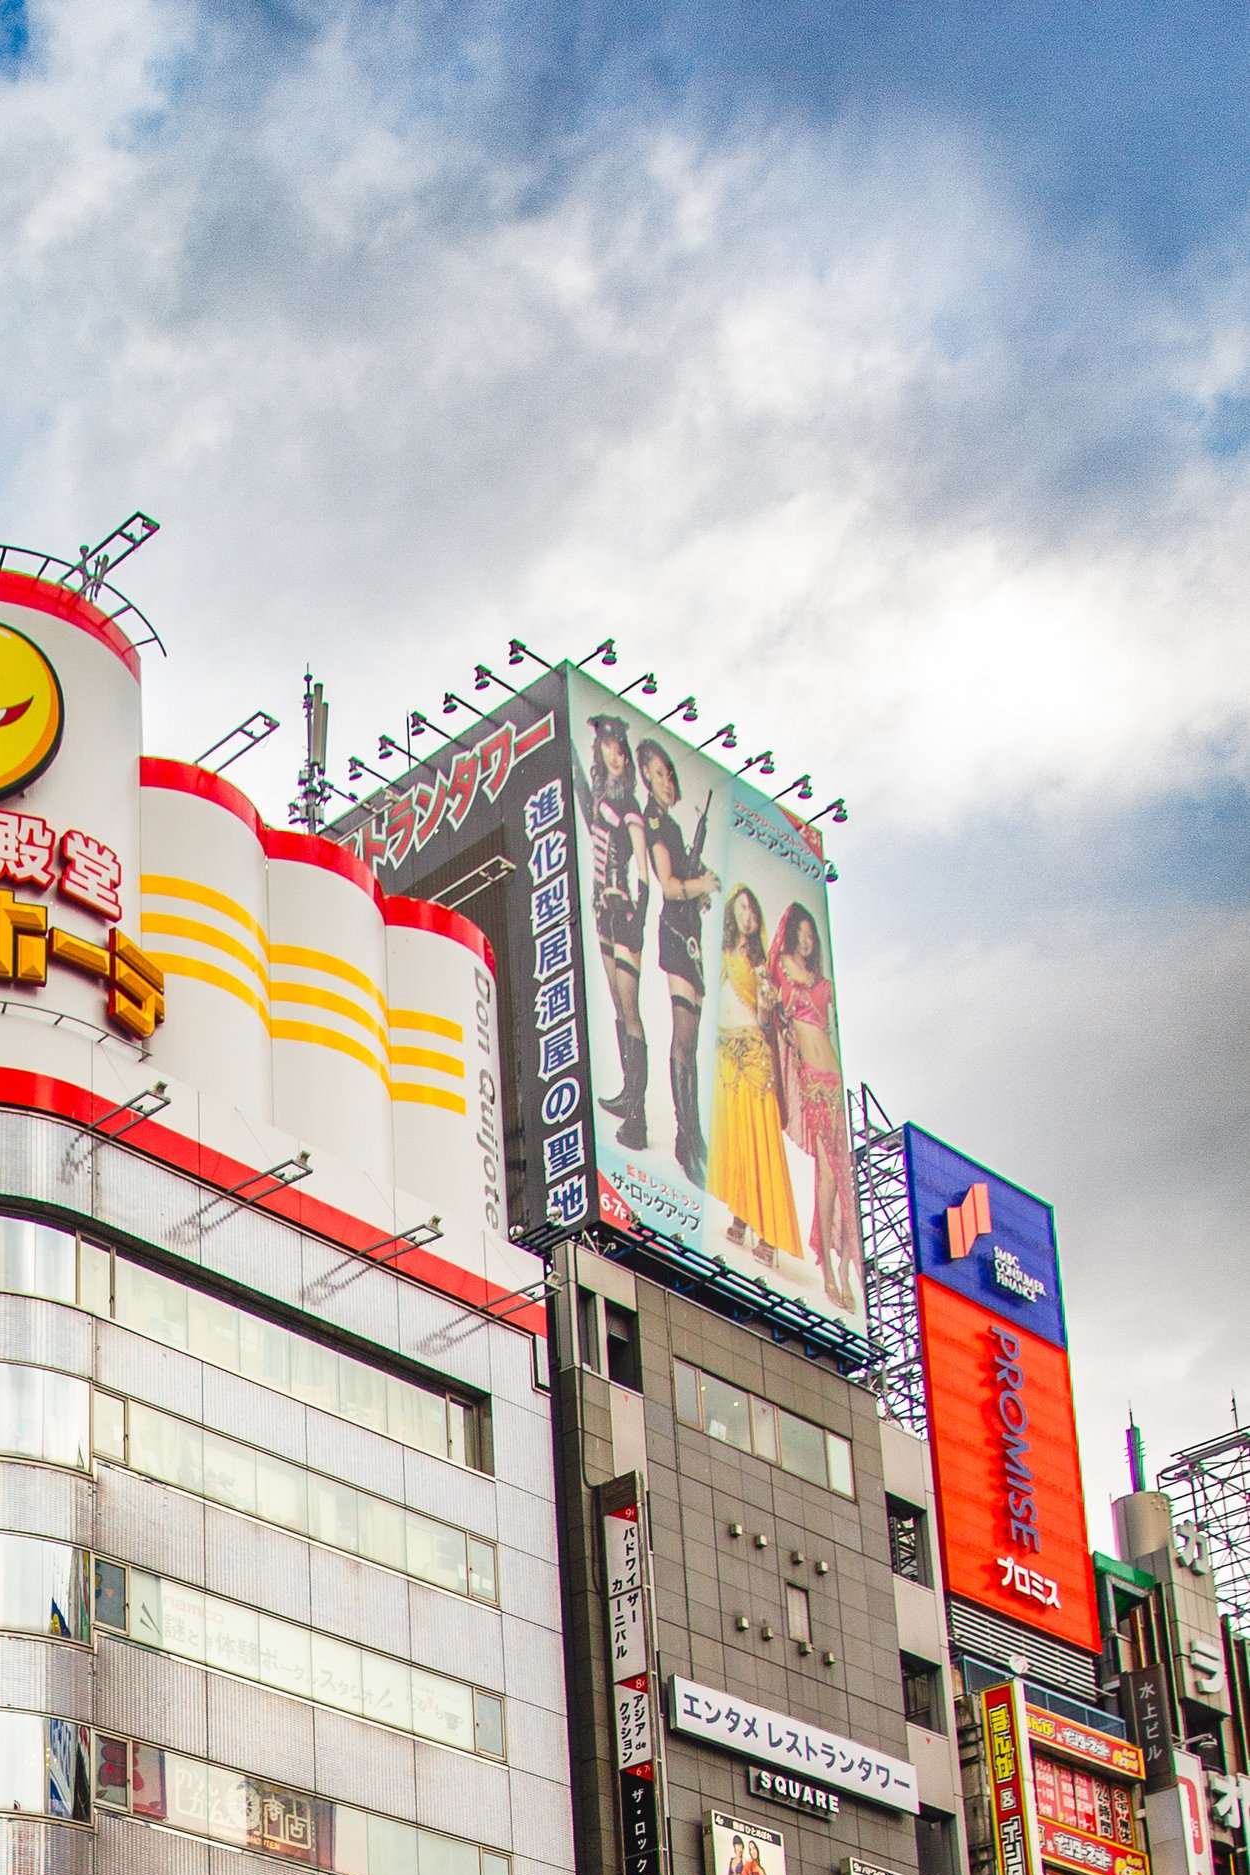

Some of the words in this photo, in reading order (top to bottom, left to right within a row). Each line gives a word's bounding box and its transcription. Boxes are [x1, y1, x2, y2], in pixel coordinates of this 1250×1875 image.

[473, 966, 492, 1054] Don
[524, 780, 587, 1227] 進化型居酒屋の聖地
[994, 1259, 1048, 1297] CONSUMER
[996, 1271, 1038, 1303] FINANCE
[991, 1324, 1040, 1553] PROMISE
[622, 1528, 638, 1624] バドワイザー
[997, 1556, 1062, 1610] プロミス
[611, 1577, 628, 1660] カーニバル
[633, 1693, 646, 1736] アジア
[682, 1693, 759, 1739] エンタメ
[767, 1722, 911, 1791] レストランタワー
[1138, 1679, 1165, 1763] 水上ビル
[760, 1770, 840, 1814] SQUARE
